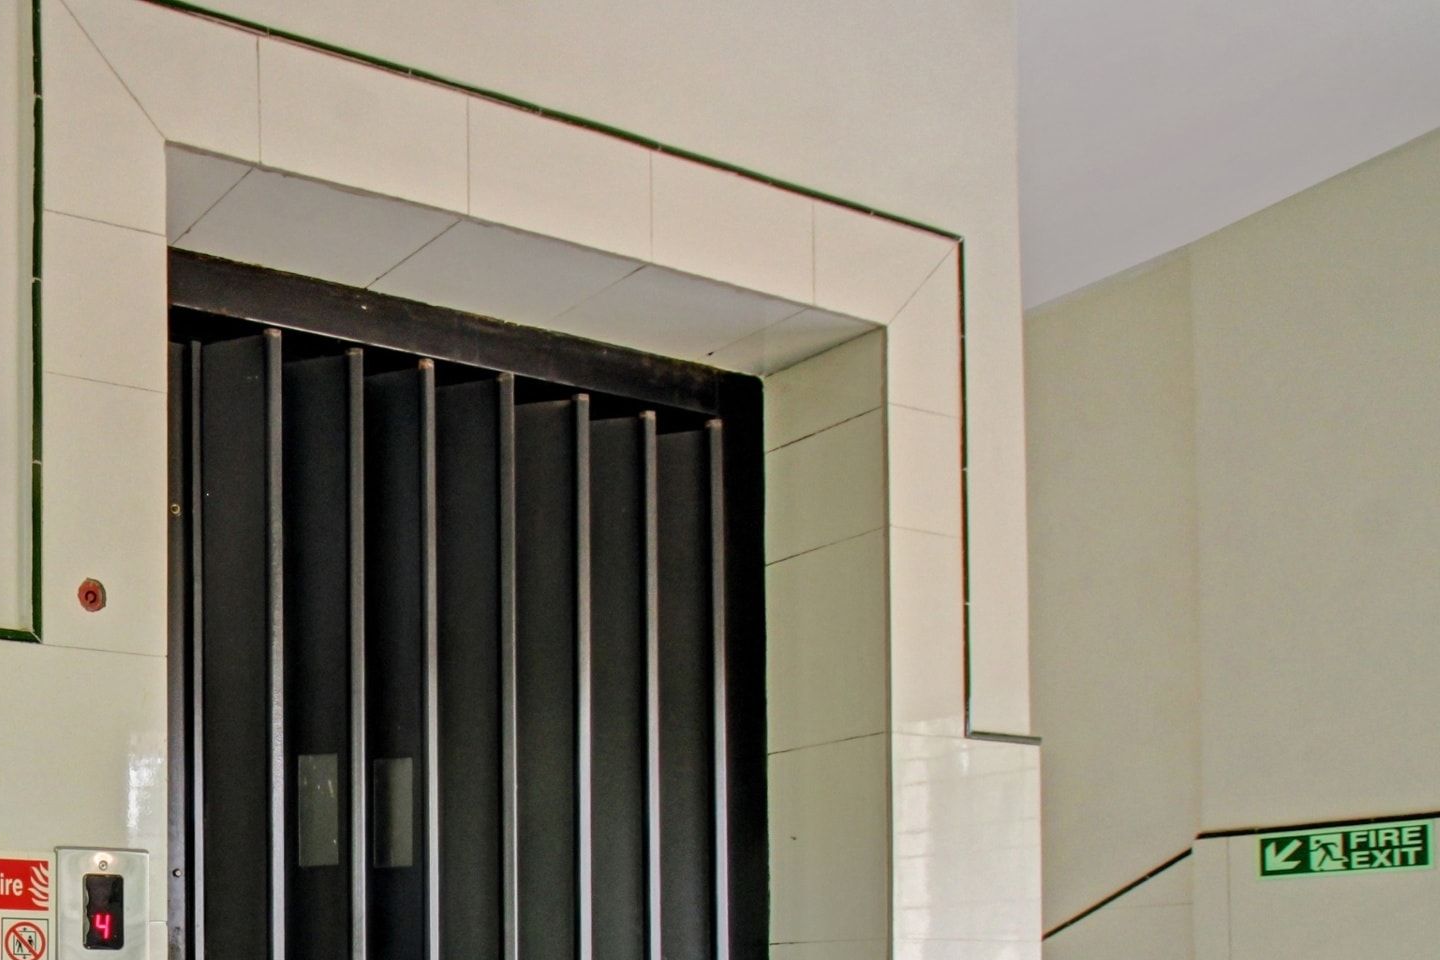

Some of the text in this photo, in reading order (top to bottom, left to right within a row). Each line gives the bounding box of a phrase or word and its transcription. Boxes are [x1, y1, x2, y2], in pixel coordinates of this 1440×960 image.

[1349, 826, 1423, 850] FIRE
[1350, 846, 1423, 869] EXIT
[94, 913, 110, 940] 4
